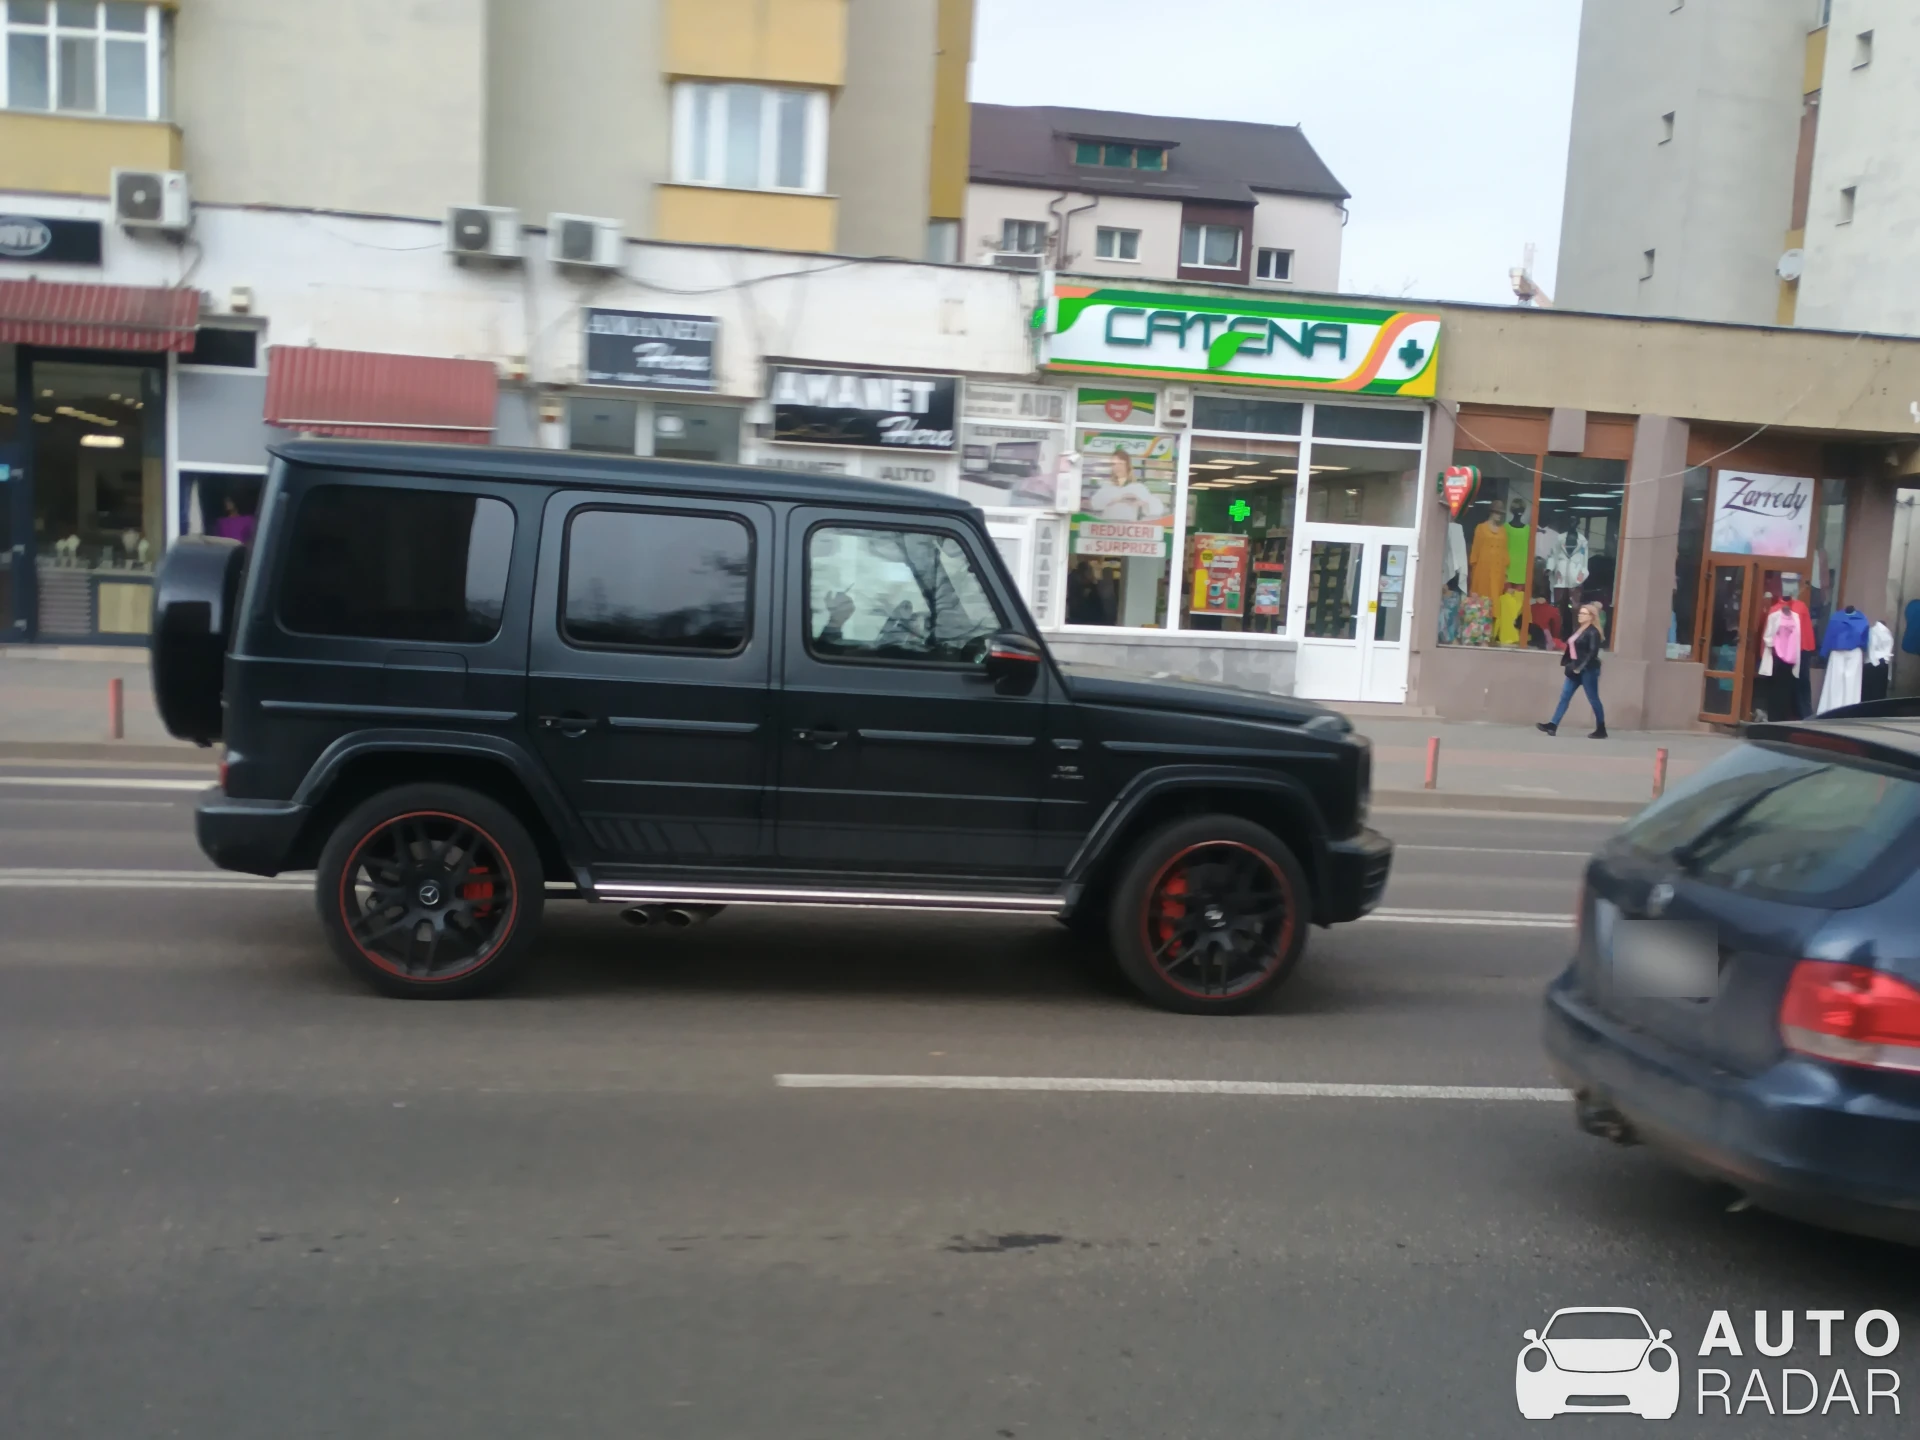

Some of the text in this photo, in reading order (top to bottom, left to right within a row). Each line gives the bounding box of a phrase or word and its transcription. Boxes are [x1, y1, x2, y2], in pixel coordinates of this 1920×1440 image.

[1105, 307, 1348, 369] CATENA
[771, 372, 936, 414] AMANET
[880, 467, 935, 483] AUTO
[1722, 476, 1807, 520] Zarredy
[1090, 524, 1154, 538] REDUCERI
[1095, 541, 1157, 554] SURPRIZE
